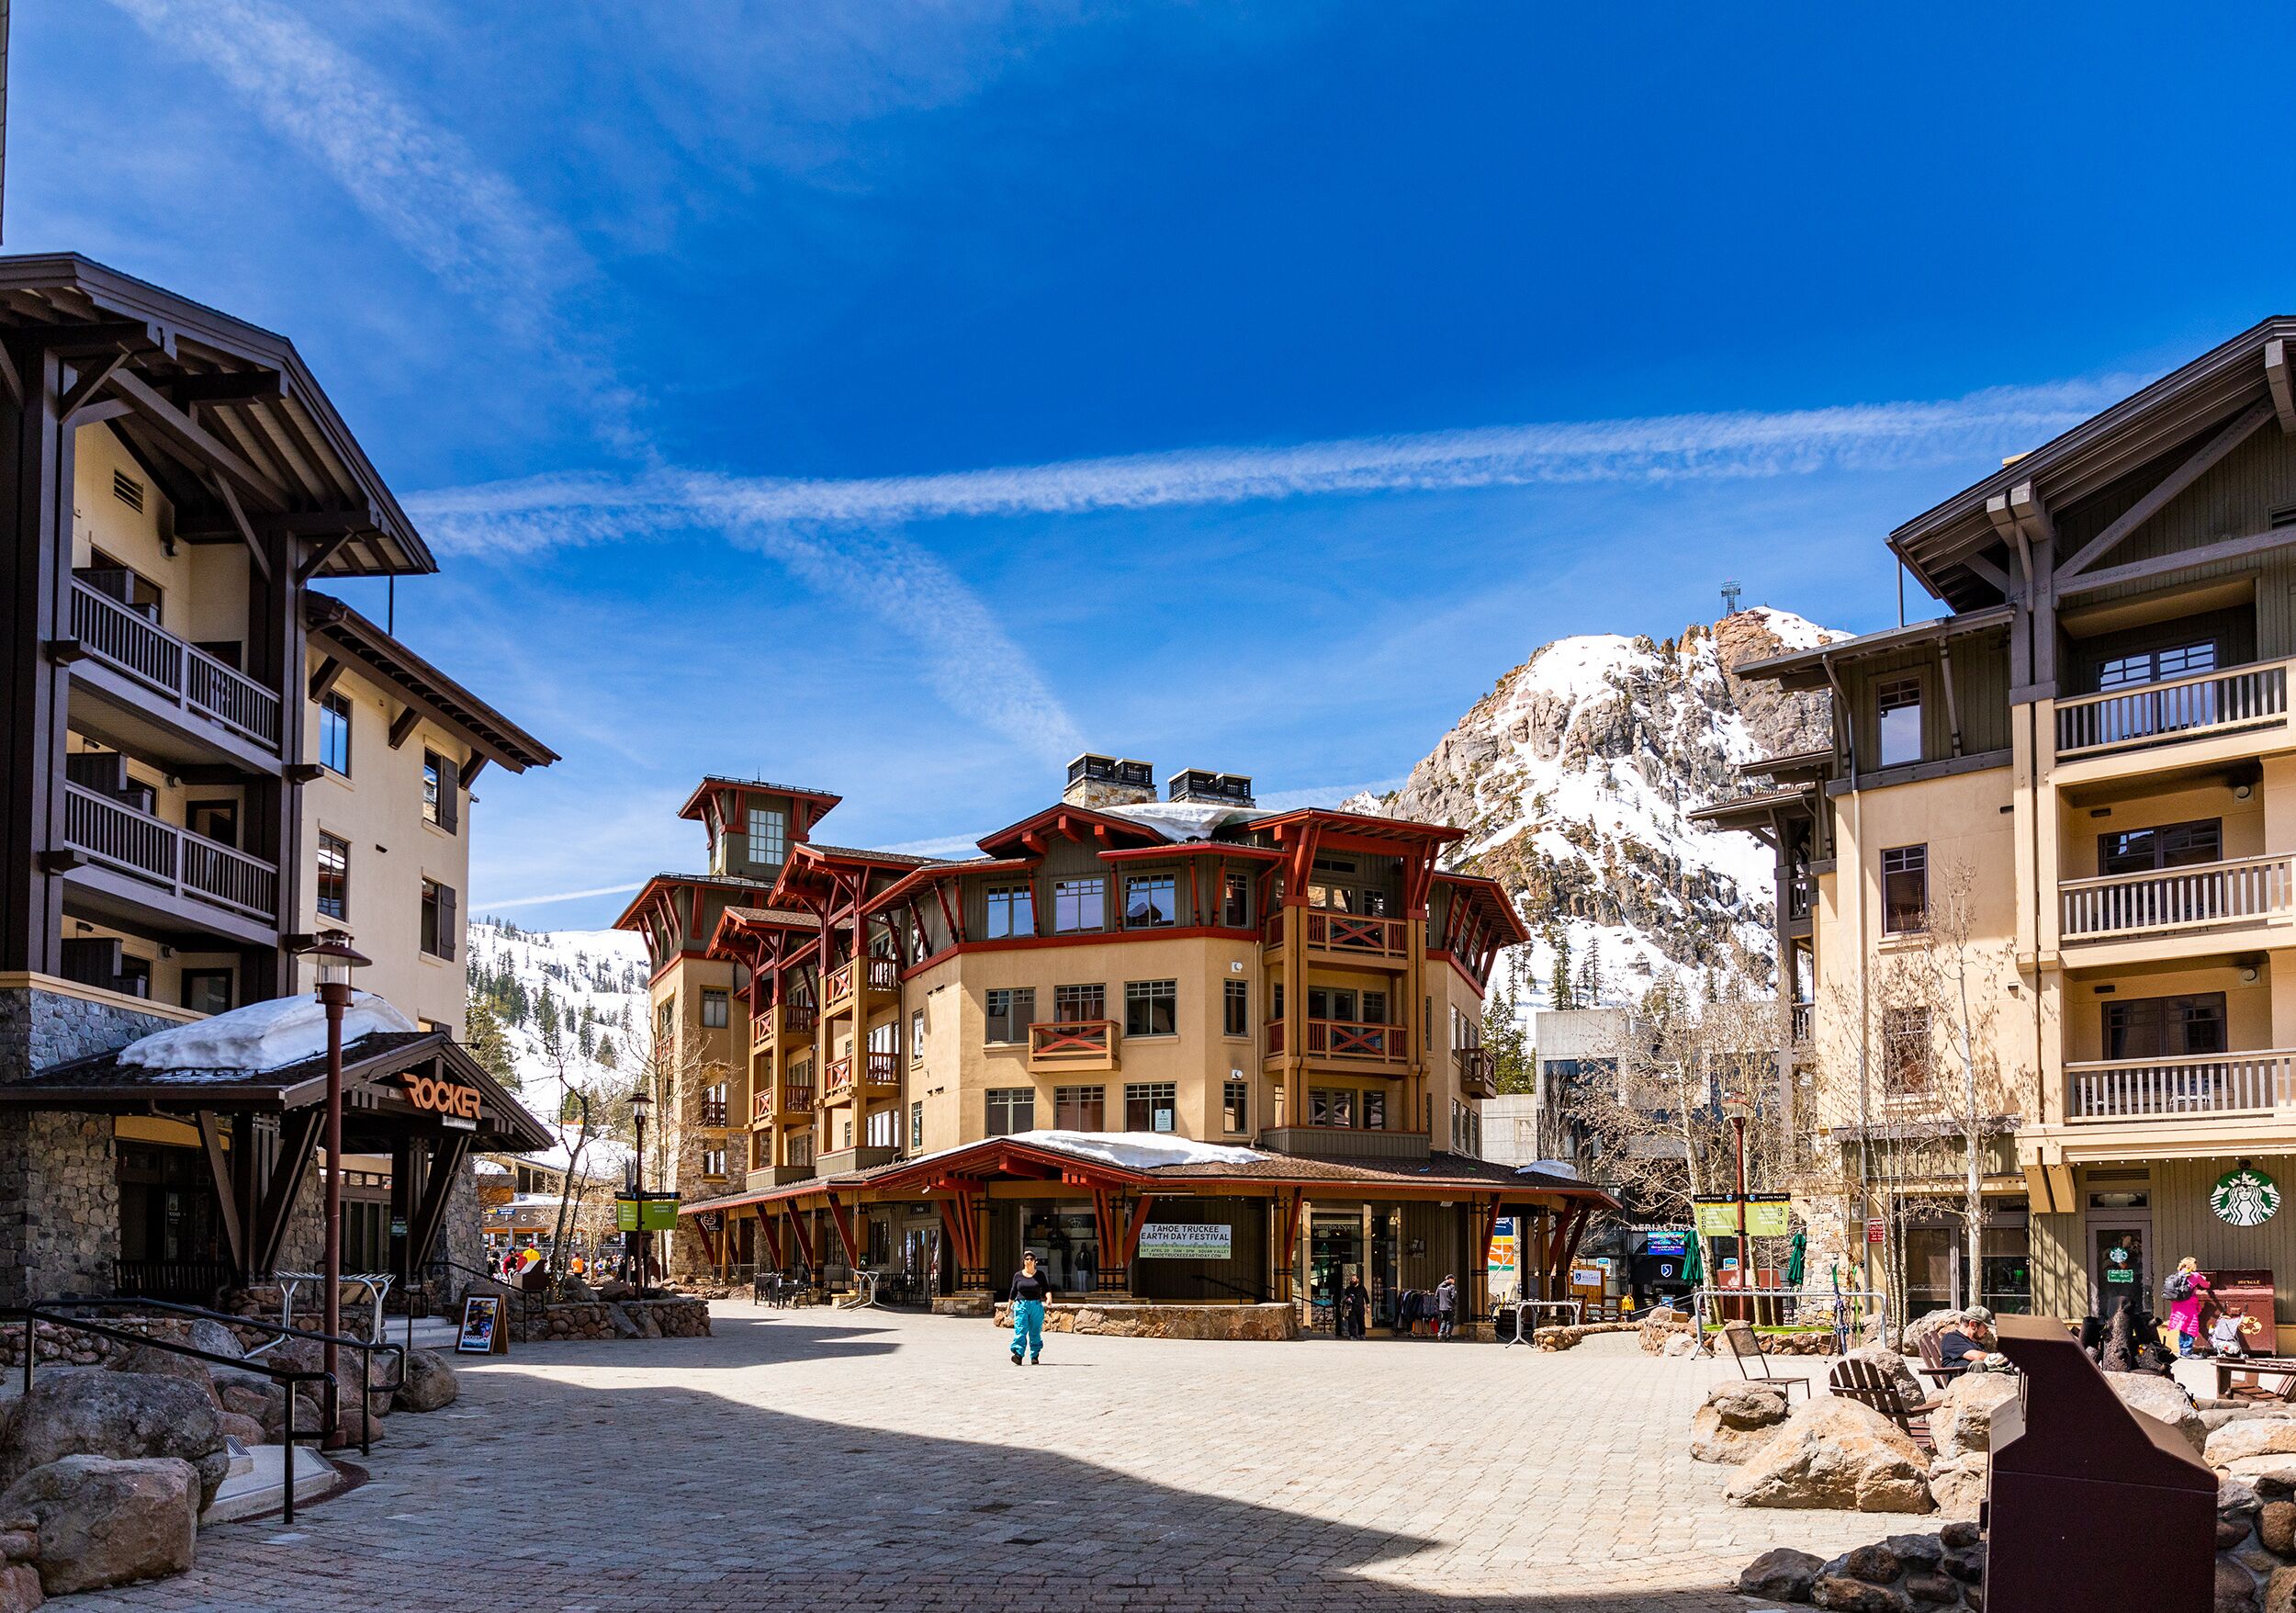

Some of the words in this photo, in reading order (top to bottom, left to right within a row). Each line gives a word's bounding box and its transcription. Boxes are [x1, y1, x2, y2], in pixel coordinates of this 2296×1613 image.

[402, 1073, 482, 1120] ROCKER
[1152, 1224, 1179, 1233] TAHOE
[1141, 1232, 1169, 1240] EARTH
[1189, 1233, 1229, 1241] FESTIVAL
